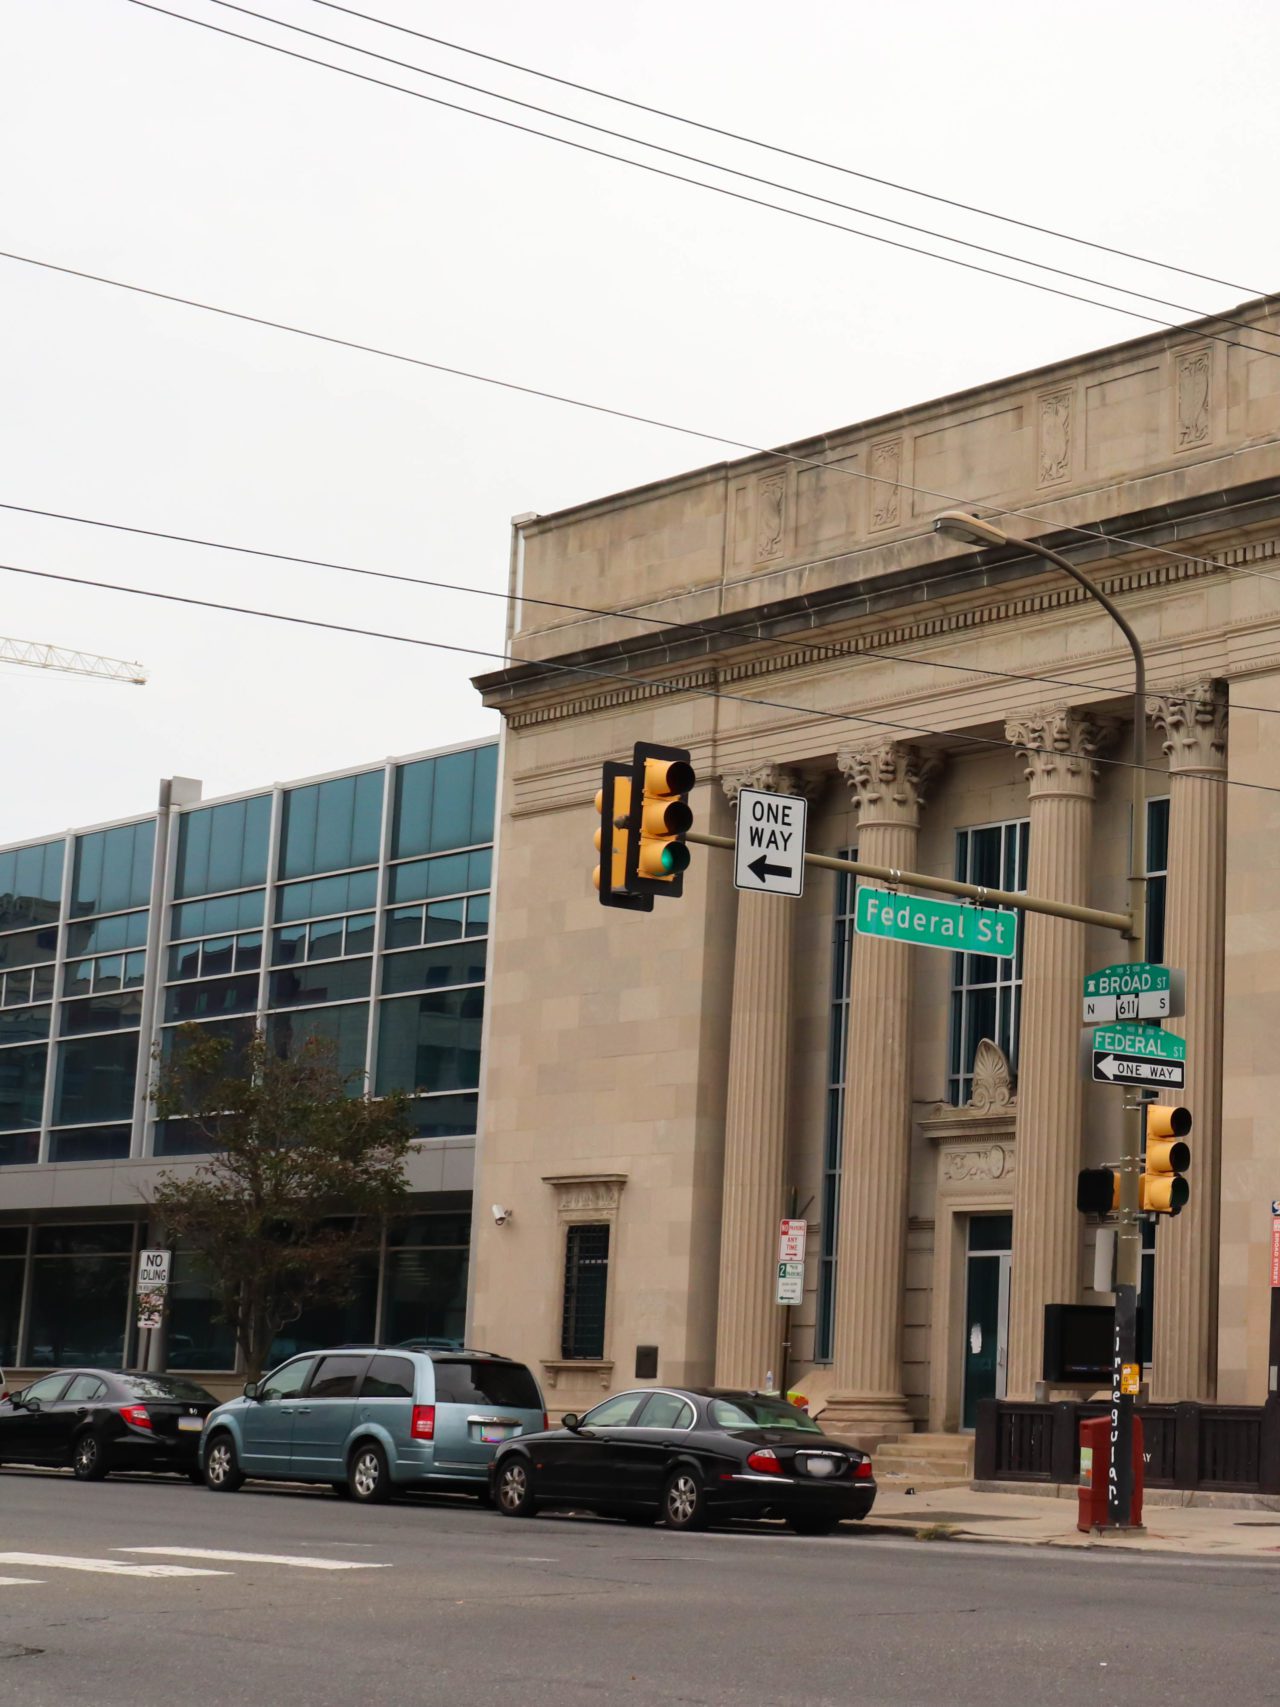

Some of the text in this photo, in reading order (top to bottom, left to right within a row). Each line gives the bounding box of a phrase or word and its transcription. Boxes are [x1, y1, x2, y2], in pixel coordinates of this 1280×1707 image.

[752, 801, 792, 826] ONE
[750, 826, 792, 852] WAY
[866, 899, 1005, 944] Federal St
[1099, 974, 1167, 993] BROAD ST
[1087, 998, 1166, 1015] N 611 S
[1094, 1032, 1183, 1058] FEDERAL ST
[1117, 1063, 1174, 1079] ONE WAY
[146, 1254, 163, 1267] NO
[141, 1269, 166, 1280] IDLING
[779, 1265, 785, 1276] 2
